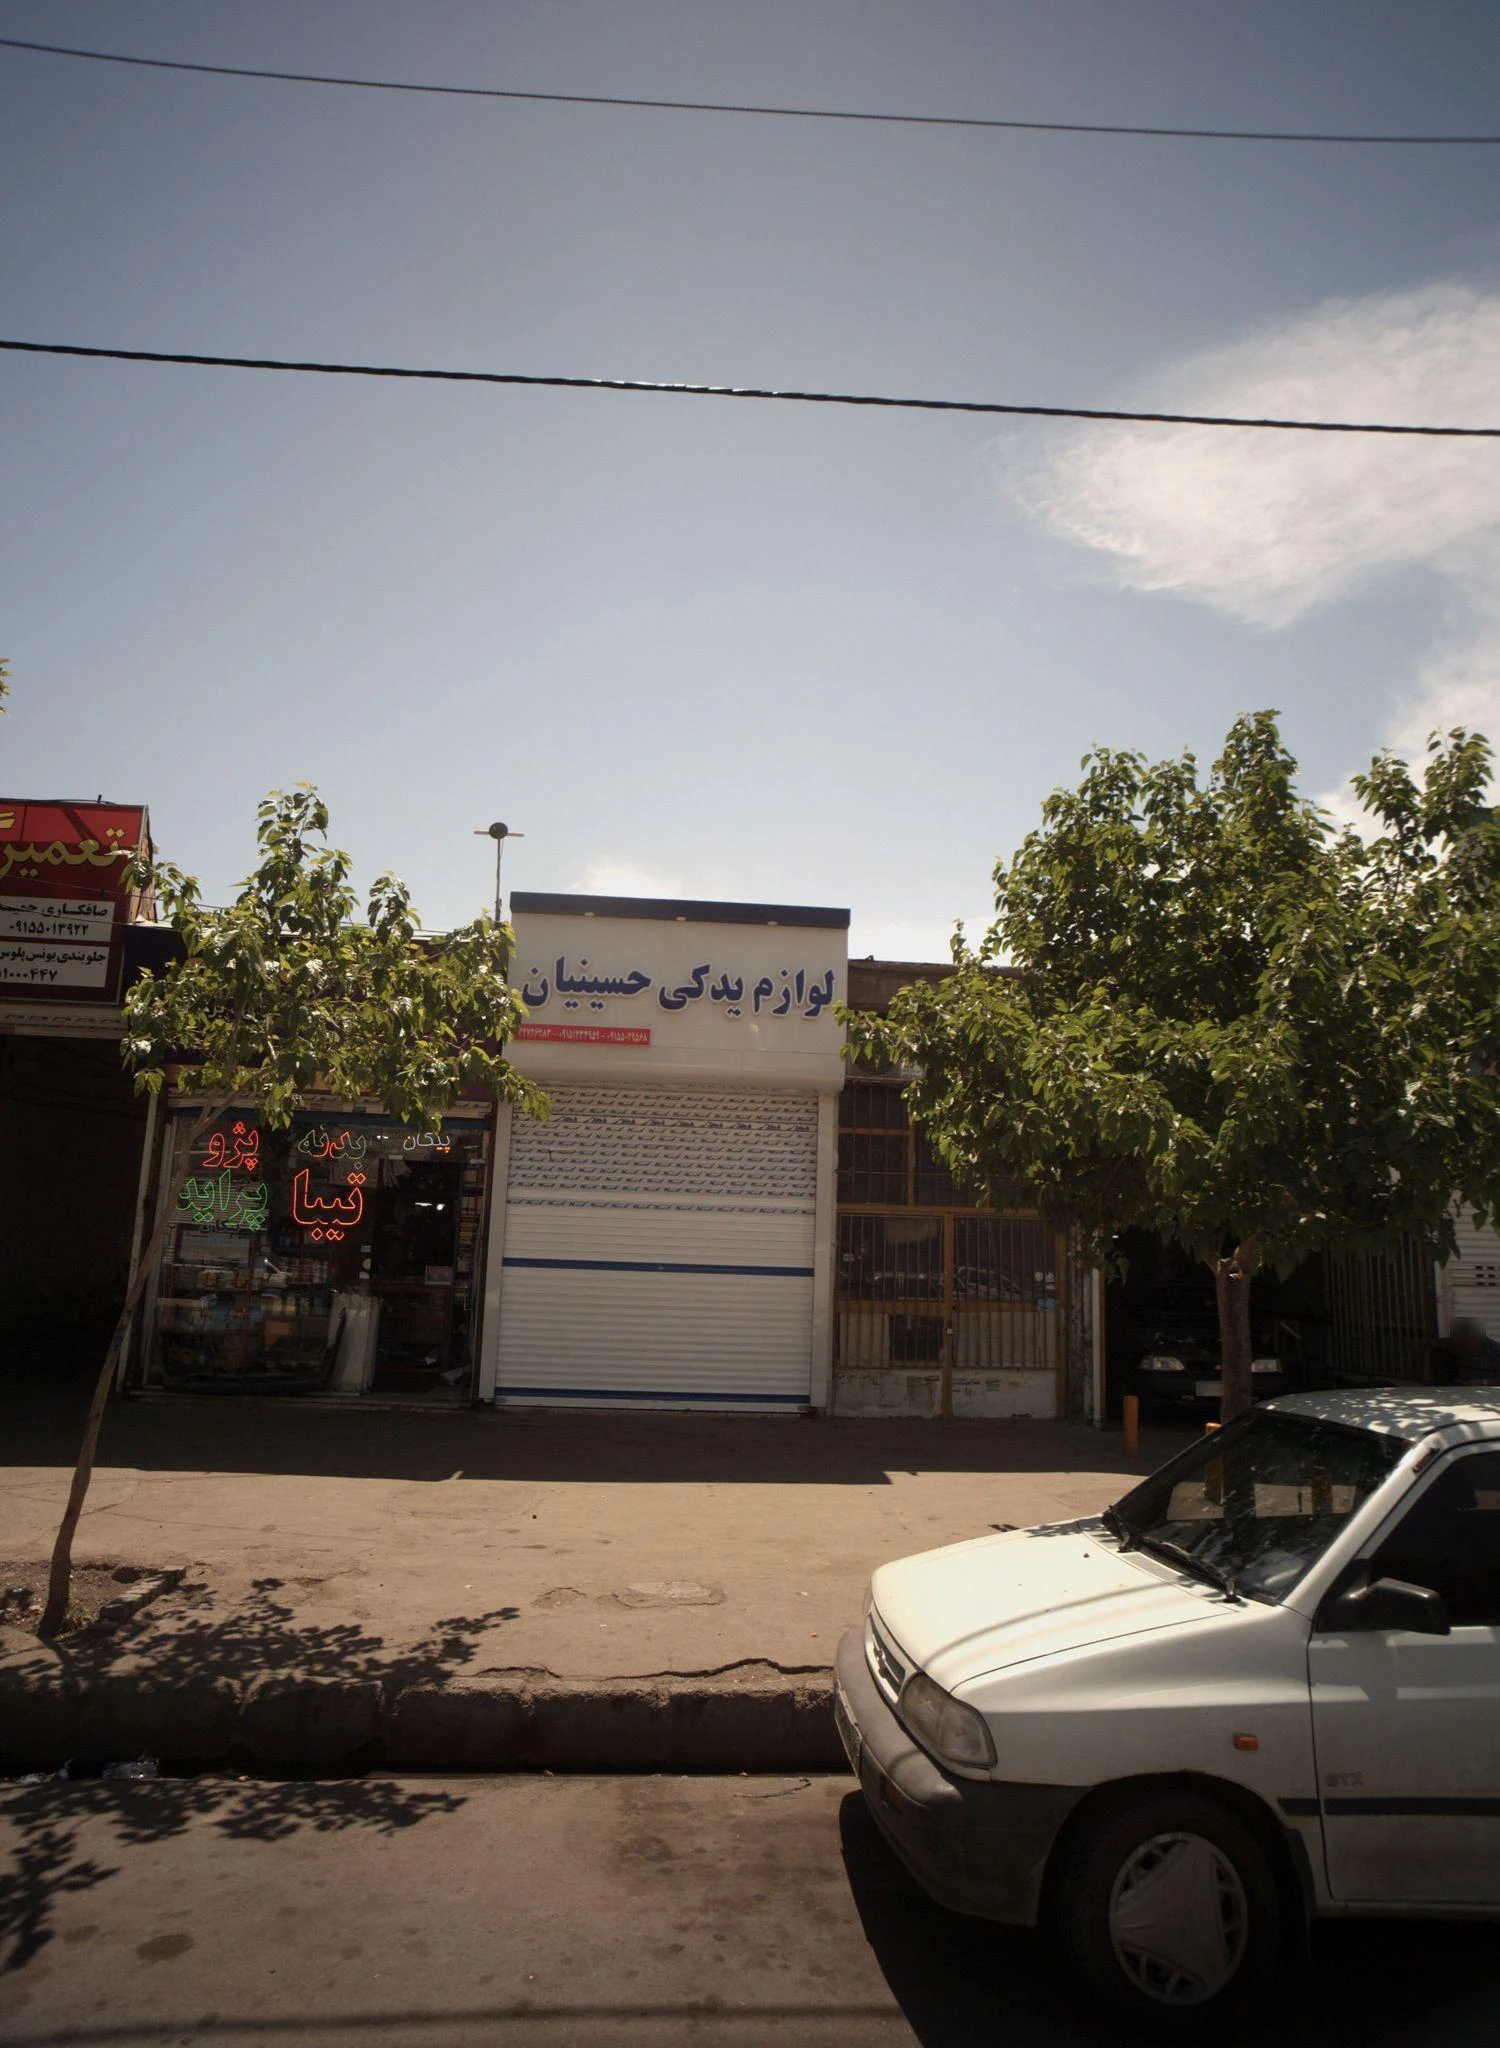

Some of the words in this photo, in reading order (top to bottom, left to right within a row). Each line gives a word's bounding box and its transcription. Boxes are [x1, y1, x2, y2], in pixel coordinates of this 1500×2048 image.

[0, 967, 58, 982] ۱۰۰۰۴۴۷
[521, 955, 652, 1010] حسینیان
[658, 963, 744, 1016] یدکی
[753, 968, 836, 1016] لوازم
[202, 1121, 259, 1171] پژو
[403, 1131, 451, 1154] پیکان
[176, 1169, 269, 1232] پراید
[293, 1169, 363, 1241] تیبا
